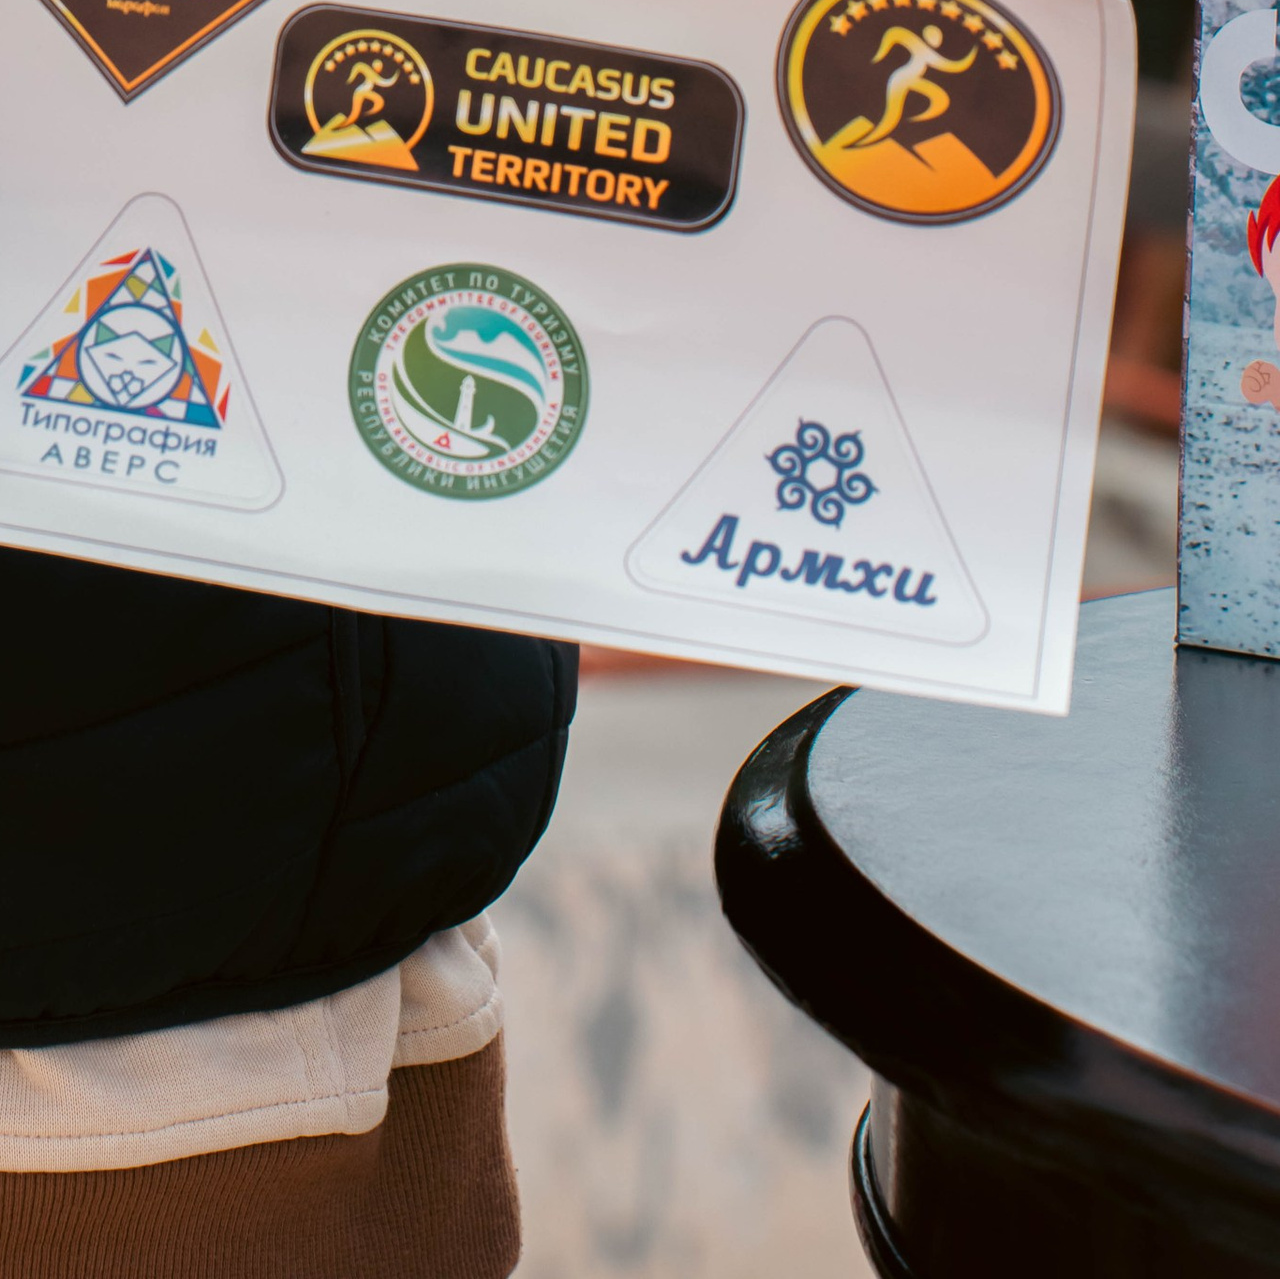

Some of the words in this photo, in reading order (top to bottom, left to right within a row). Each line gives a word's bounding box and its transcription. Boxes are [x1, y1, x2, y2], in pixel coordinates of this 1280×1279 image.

[464, 47, 676, 110] CAUCASUS
[454, 88, 673, 165] UNITED
[447, 144, 670, 211] TERRITORY
[367, 272, 456, 344] КОМИТЕТ
[469, 271, 499, 290] ПО
[510, 283, 580, 375] ТУРИЗМУ
[385, 323, 407, 351] THE
[521, 314, 560, 381] TOURISM
[20, 401, 217, 456] Типография
[357, 370, 455, 488] РЕСПУБЛИКИ
[466, 404, 578, 491] ИНГУШЕТИЯ
[40, 442, 181, 485] АВЕРС
[680, 513, 937, 607] Армхи
